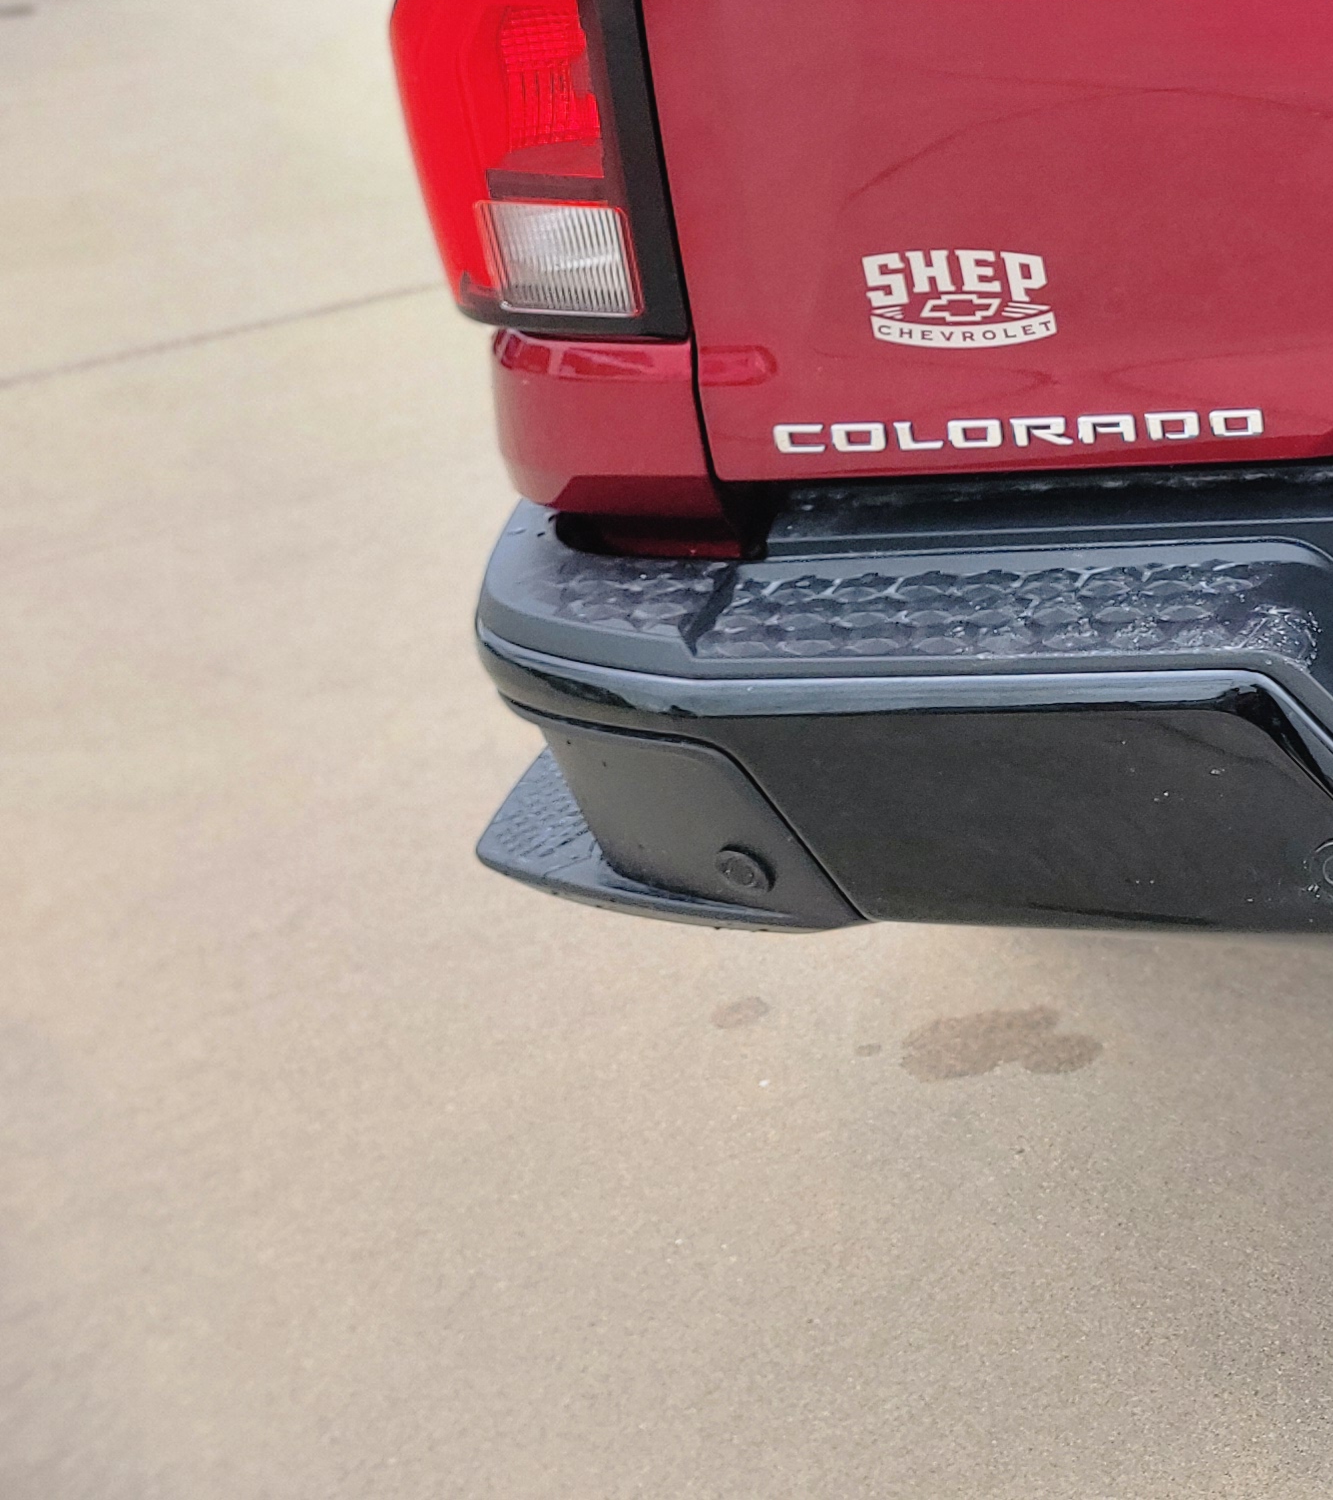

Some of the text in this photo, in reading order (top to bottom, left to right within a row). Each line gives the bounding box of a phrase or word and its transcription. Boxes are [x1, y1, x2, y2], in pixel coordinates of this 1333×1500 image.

[862, 249, 1048, 307] SHEP
[877, 320, 1052, 342] CHEVROLET
[772, 407, 1264, 454] COLORADO
